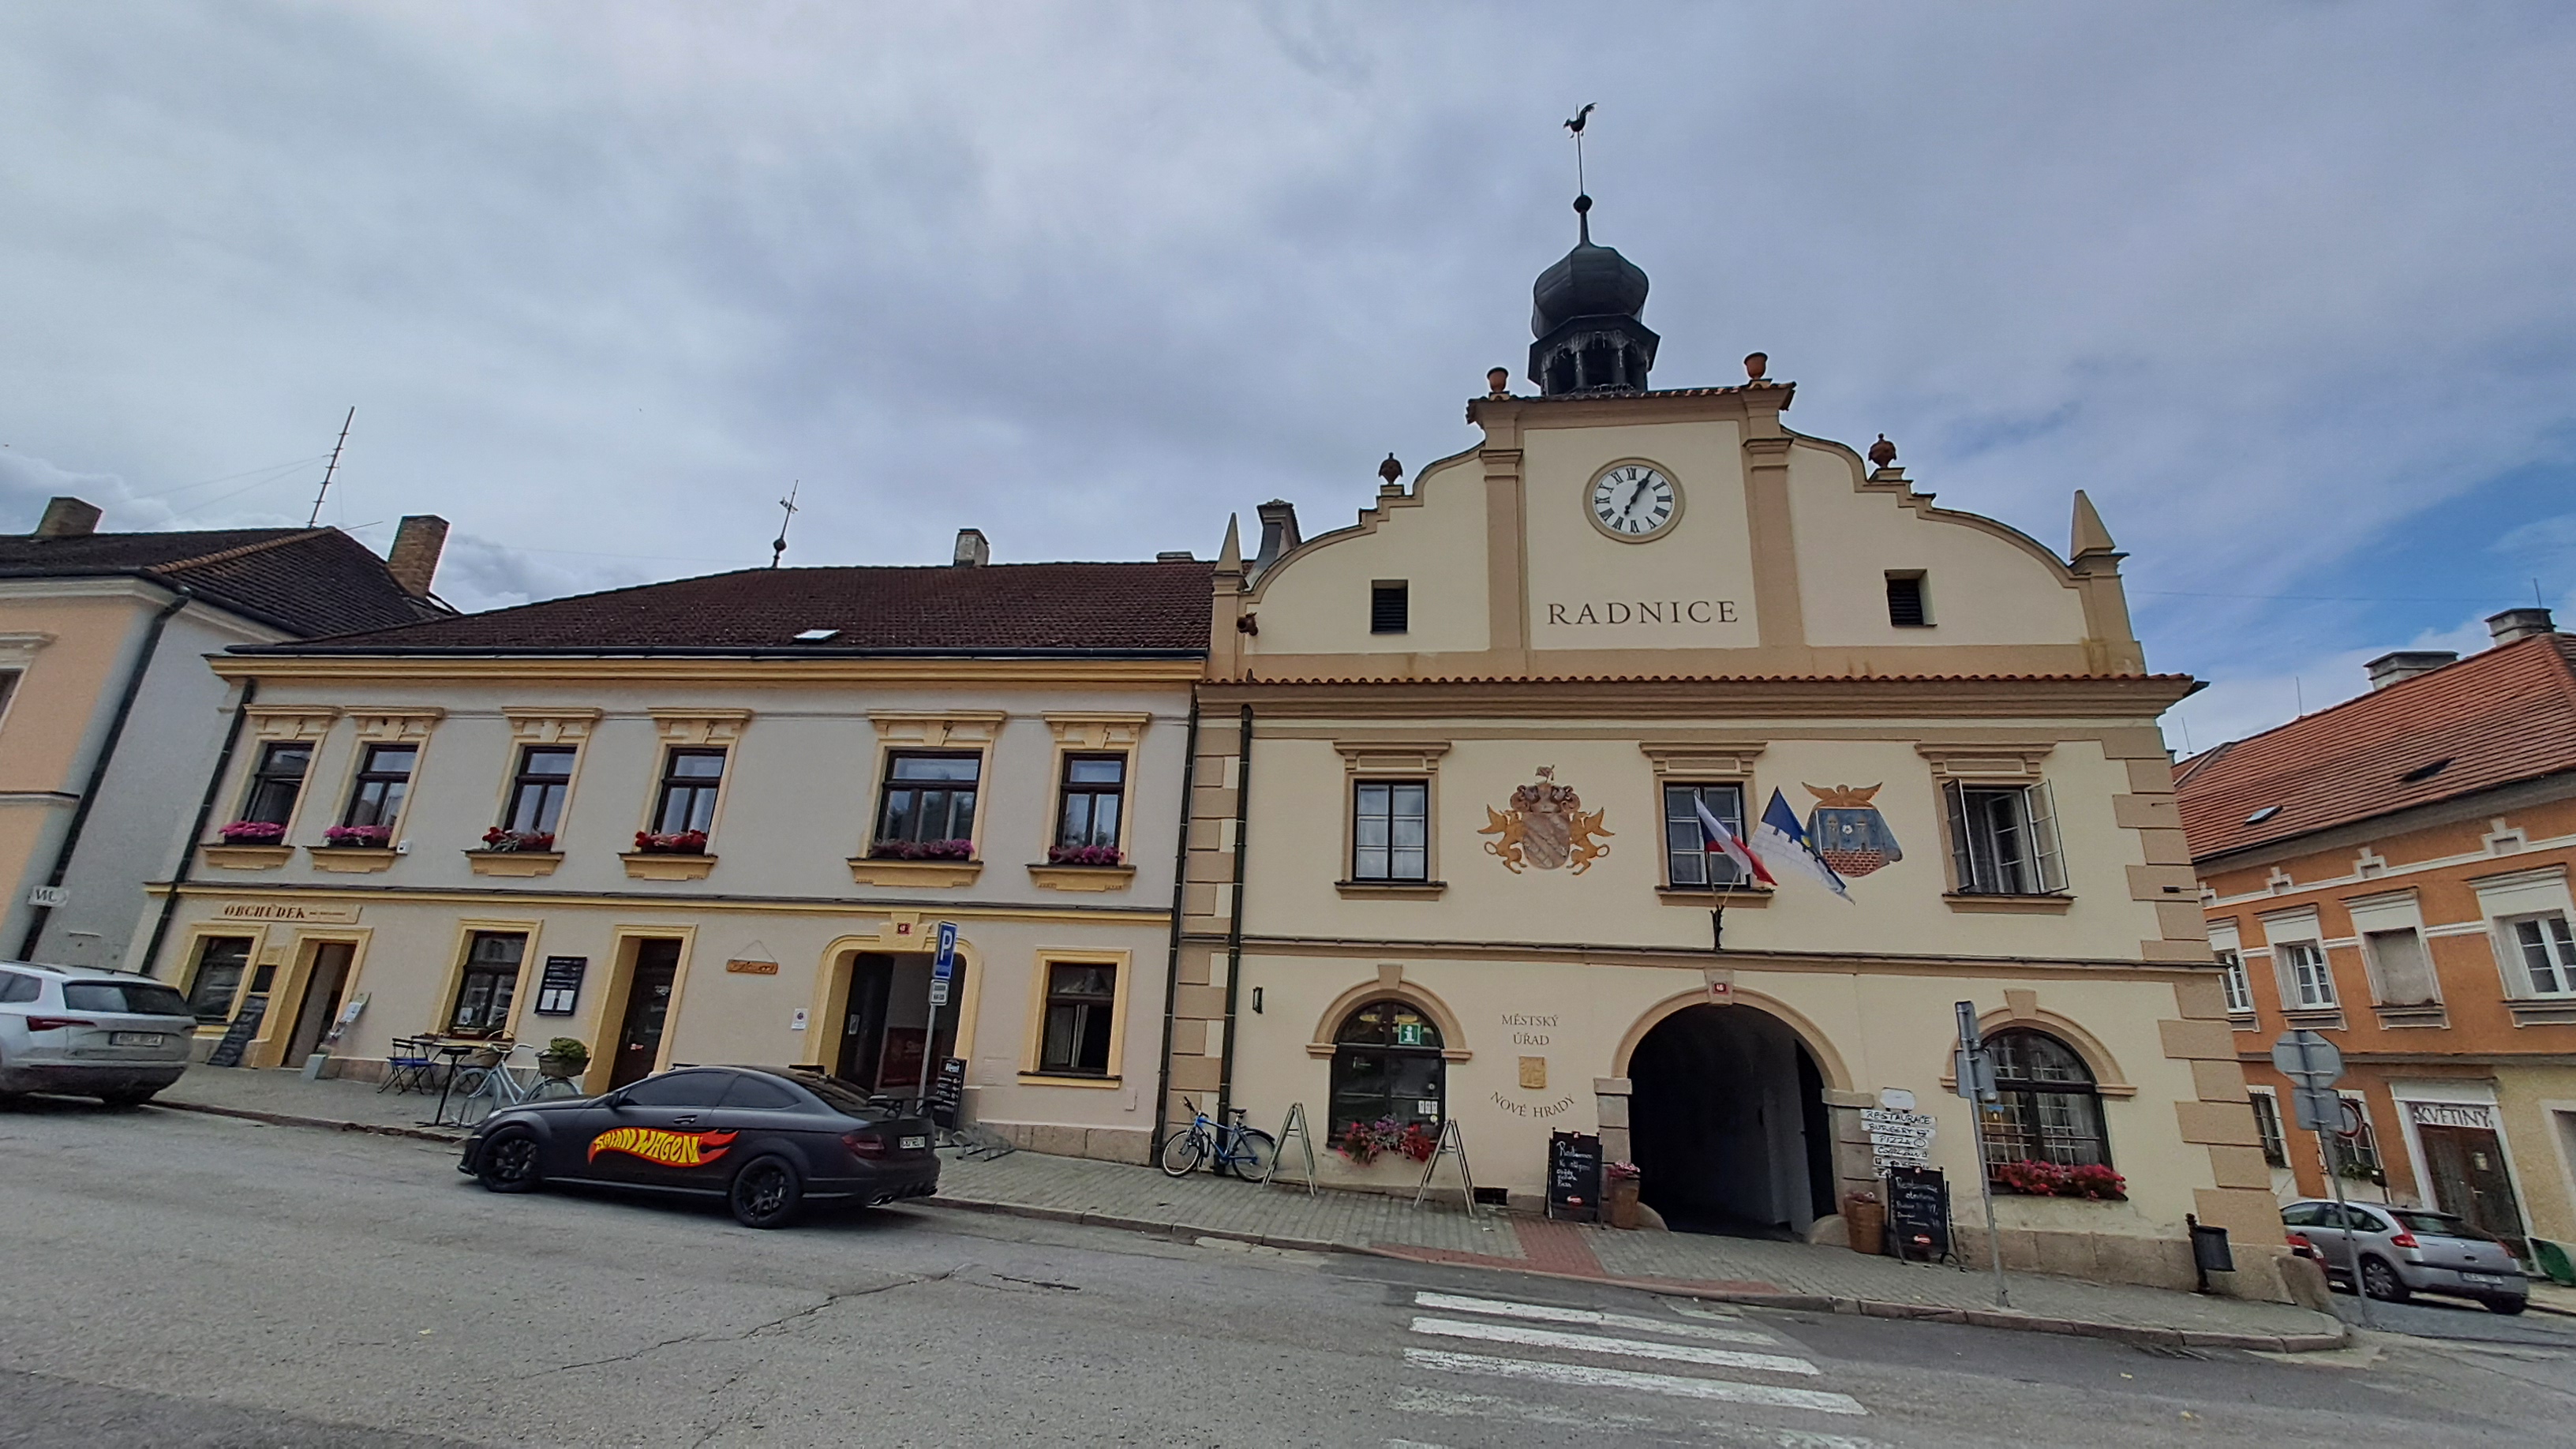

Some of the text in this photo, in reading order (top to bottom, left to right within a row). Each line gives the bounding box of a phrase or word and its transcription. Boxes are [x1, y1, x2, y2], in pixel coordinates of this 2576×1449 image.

[1547, 600, 1739, 624] RADNICE
[940, 930, 953, 961] P
[1501, 1013, 1559, 1027] MĚSTSKÝ
[1513, 1032, 1549, 1046] ÚŘAD
[1490, 1091, 1575, 1118] NOVÉ HRADY
